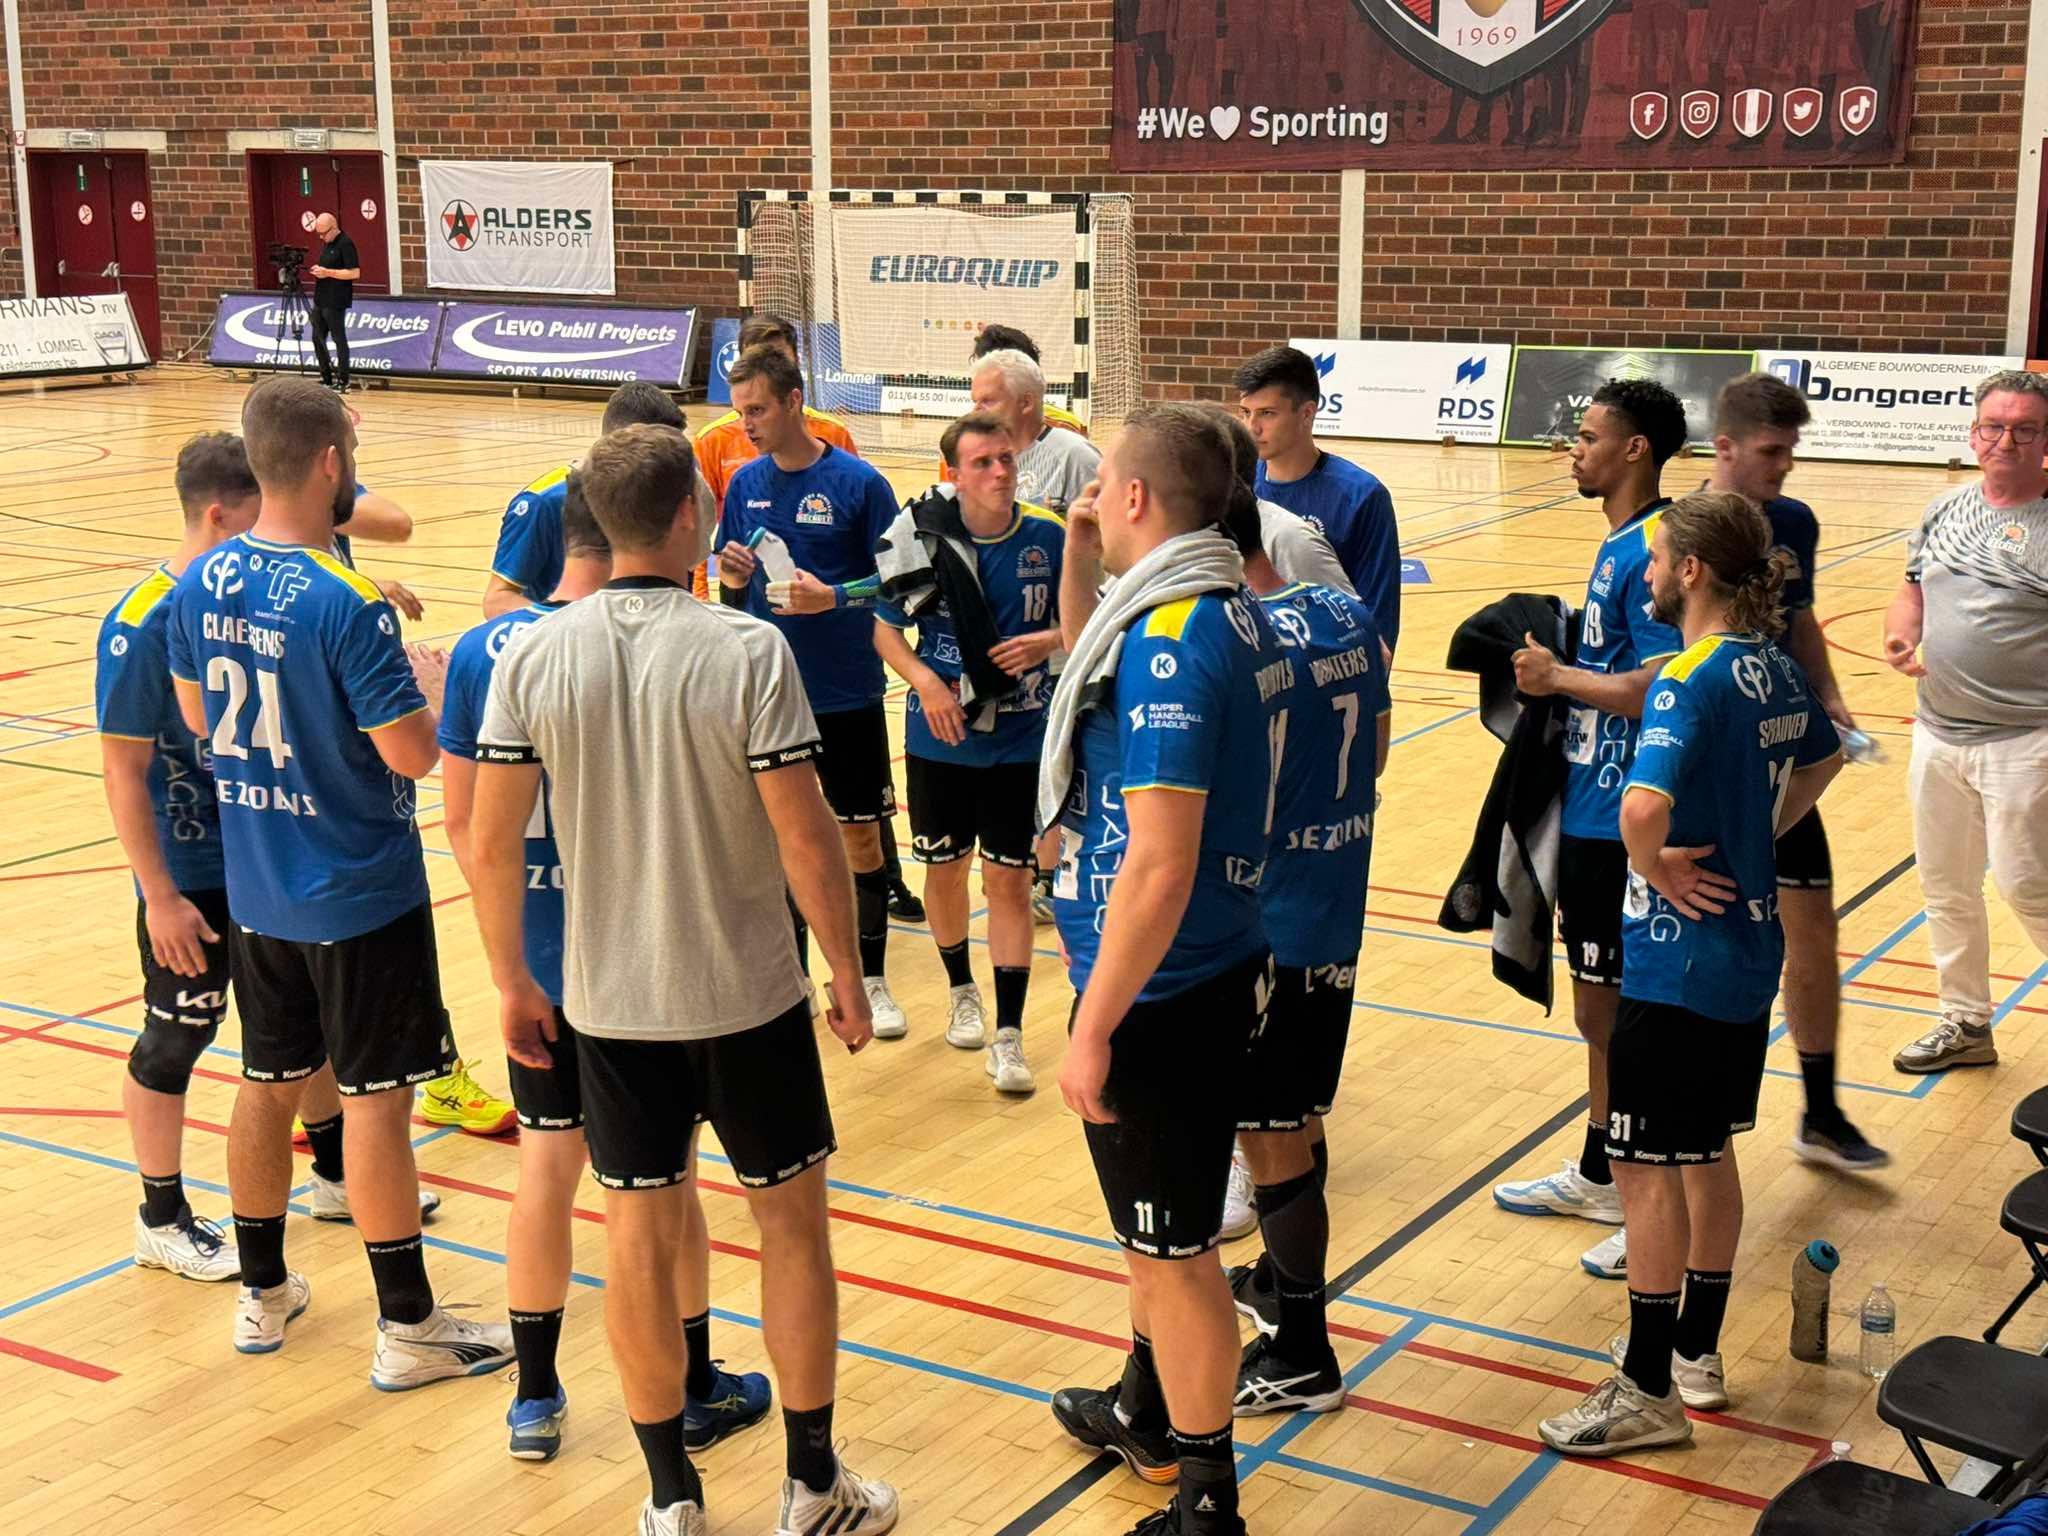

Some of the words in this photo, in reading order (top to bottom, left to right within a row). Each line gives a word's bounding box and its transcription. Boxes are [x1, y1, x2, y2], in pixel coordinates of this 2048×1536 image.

[1456, 26, 1517, 46] 1969
[1137, 107, 1205, 140] #We
[1249, 105, 1389, 145] Sporting
[483, 207, 592, 230] ALDERS
[484, 230, 593, 249] TRANSPORT
[869, 254, 1061, 290] EUROQUIP
[101, 302, 118, 314] nv
[357, 313, 430, 333] Projects
[494, 319, 545, 336] LEVO
[548, 321, 597, 339] Publi
[600, 324, 678, 344] Projects
[37, 338, 88, 354] LOMMEL
[255, 352, 301, 366] SPORTS
[1815, 360, 1877, 372] ALGEMENE
[486, 364, 538, 378] SPORTS
[541, 366, 638, 382] ADVERTISING
[825, 368, 877, 385] Lommel
[1438, 397, 1495, 420] RDS
[1826, 419, 1892, 429] VERBOUWING
[1899, 422, 1936, 431] TOTALE
[1022, 583, 1048, 623] 18
[1582, 600, 1604, 648] 19
[207, 656, 293, 769] 24
[1149, 703, 1184, 711] SUPER
[1149, 712, 1204, 723] HANDBALL
[1149, 721, 1190, 730] LEAGUE
[488, 748, 524, 761] Kempa
[780, 746, 812, 764] Kempa
[1332, 693, 1359, 801] 7
[1582, 941, 1600, 968] 19
[247, 1067, 275, 1081] Kempa
[282, 1066, 312, 1080] Kempa
[364, 1079, 398, 1092] Kempa
[405, 1069, 437, 1083] Kempa
[540, 1116, 573, 1128] Kempa
[1237, 1120, 1261, 1129] empa
[1269, 1119, 1299, 1129] Kempa
[1610, 1111, 1631, 1141] 31
[1634, 1149, 1668, 1163] Kempa
[1675, 1151, 1703, 1162] Kempa
[633, 1176, 669, 1188] Kempa
[1134, 1201, 1154, 1235] 11
[1168, 1244, 1202, 1258] Kempa
